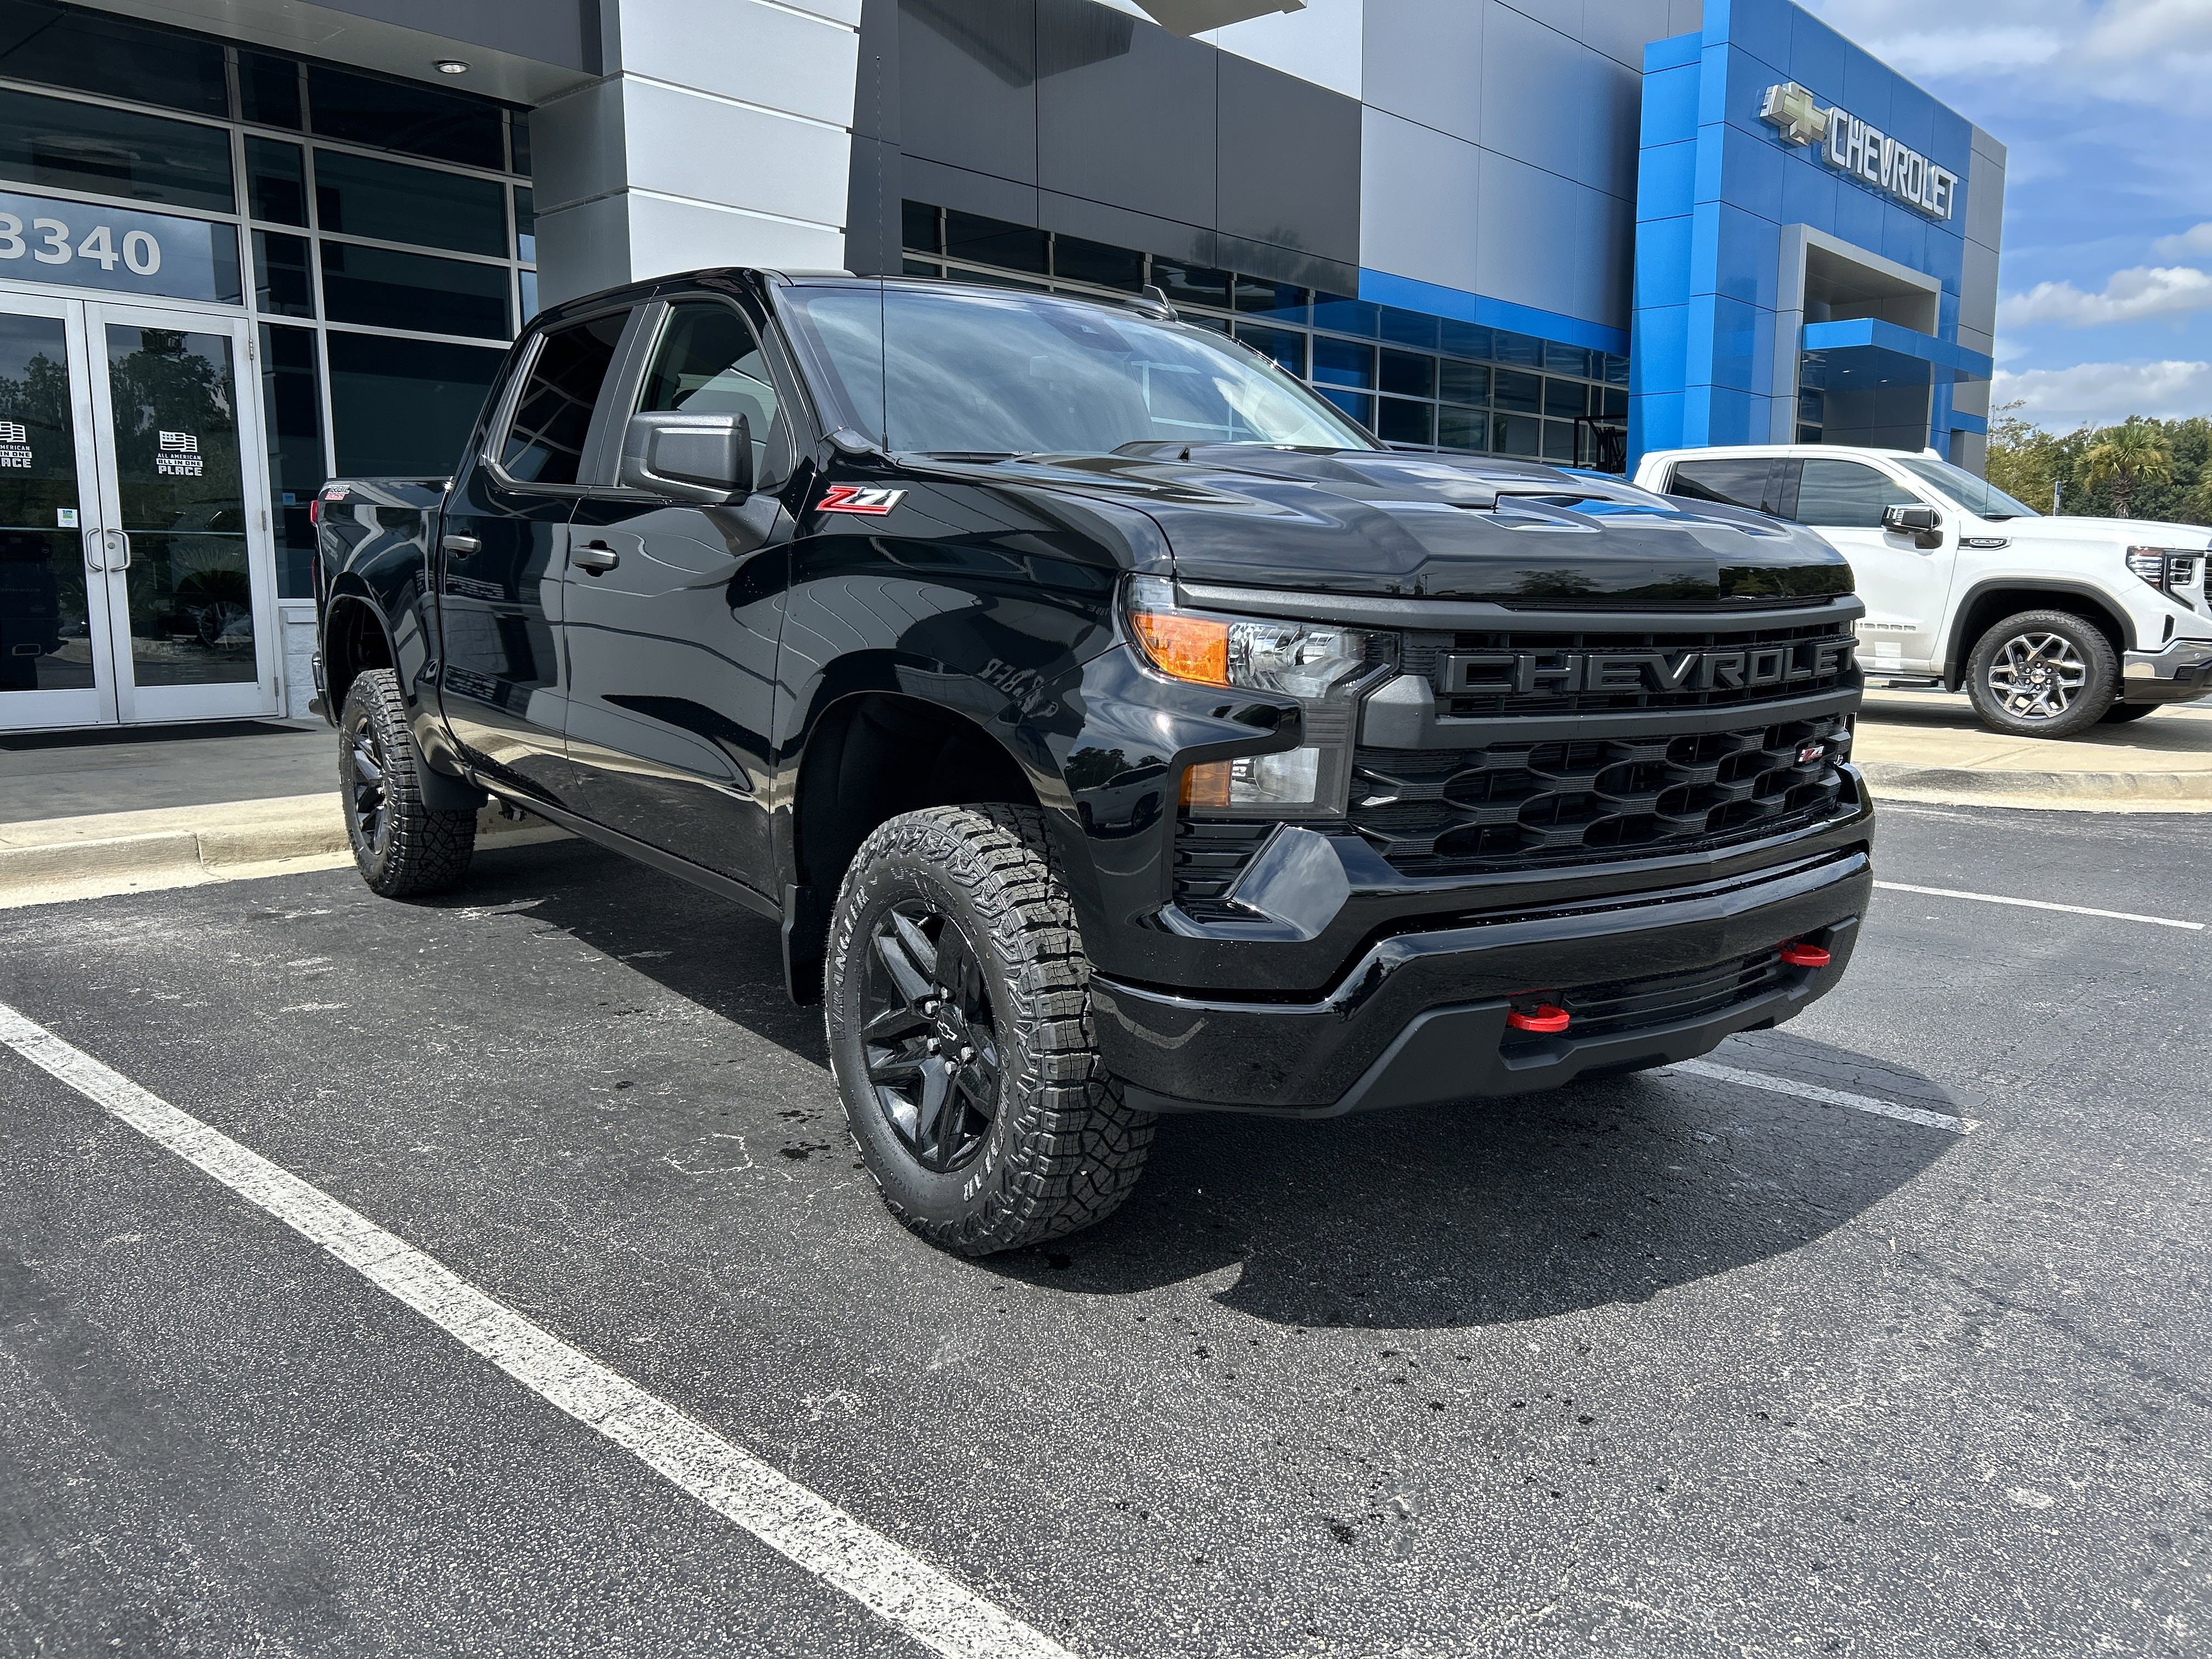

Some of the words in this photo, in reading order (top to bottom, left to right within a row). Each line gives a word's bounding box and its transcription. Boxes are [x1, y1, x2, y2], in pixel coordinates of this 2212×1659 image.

[1822, 107, 1958, 220] CHEVROLET
[0, 212, 160, 275] 3340
[158, 465, 202, 476] PLACE
[328, 484, 350, 494] TRAIL
[815, 486, 910, 517] Z71
[1443, 638, 1860, 693] CHEVROLET
[832, 885, 870, 1040] WRANGLER
